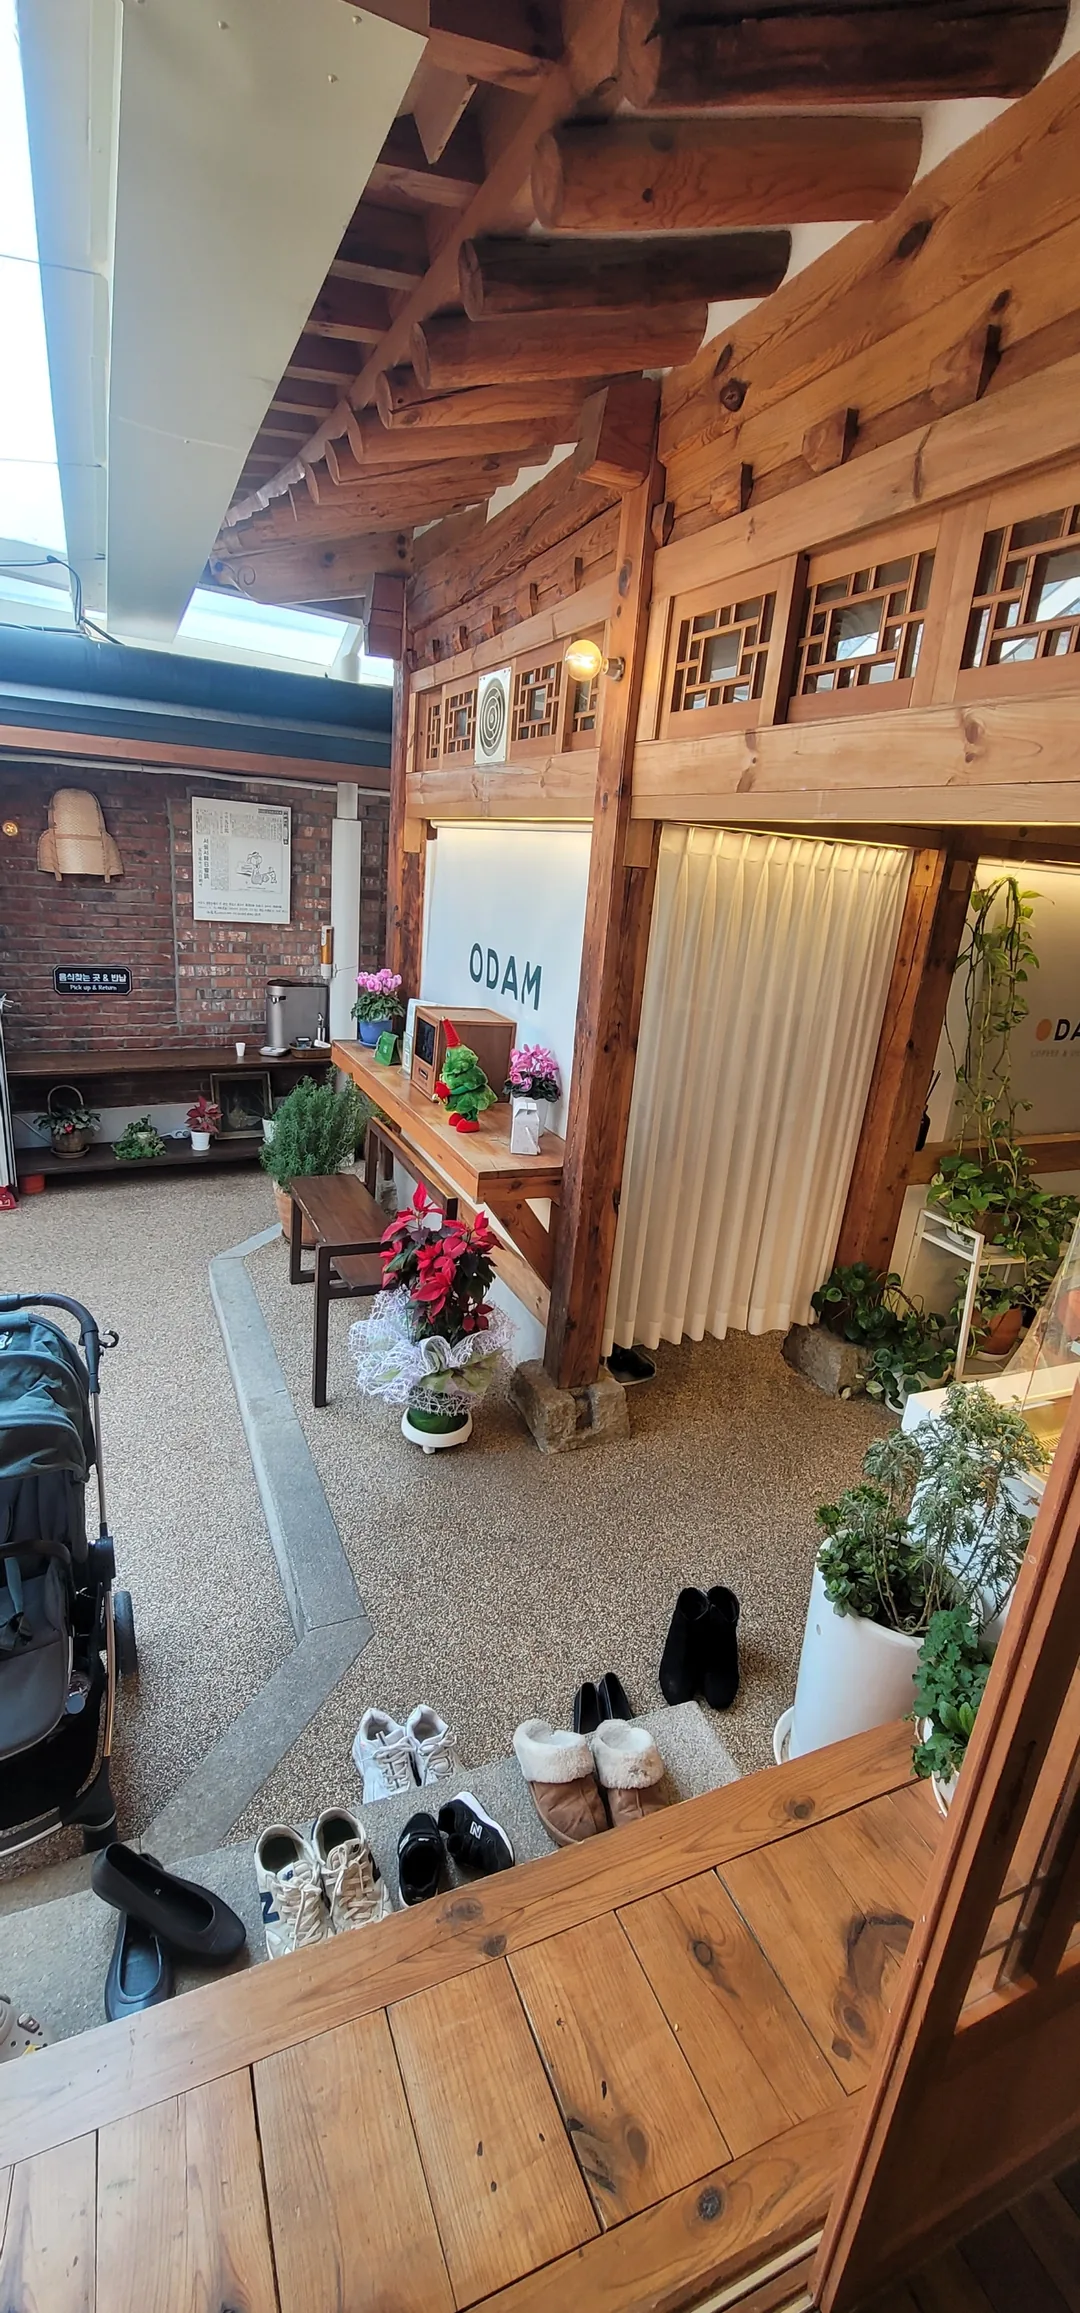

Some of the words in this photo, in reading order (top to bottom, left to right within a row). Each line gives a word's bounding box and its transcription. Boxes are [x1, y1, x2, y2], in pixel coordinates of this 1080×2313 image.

[59, 973, 90, 981] 음식찾는
[92, 973, 100, 981] 곳
[103, 973, 109, 982] &
[111, 974, 127, 982] 반납
[469, 942, 542, 1011] ODAM
[469, 1820, 483, 1840] N
[259, 1891, 280, 1924] N
